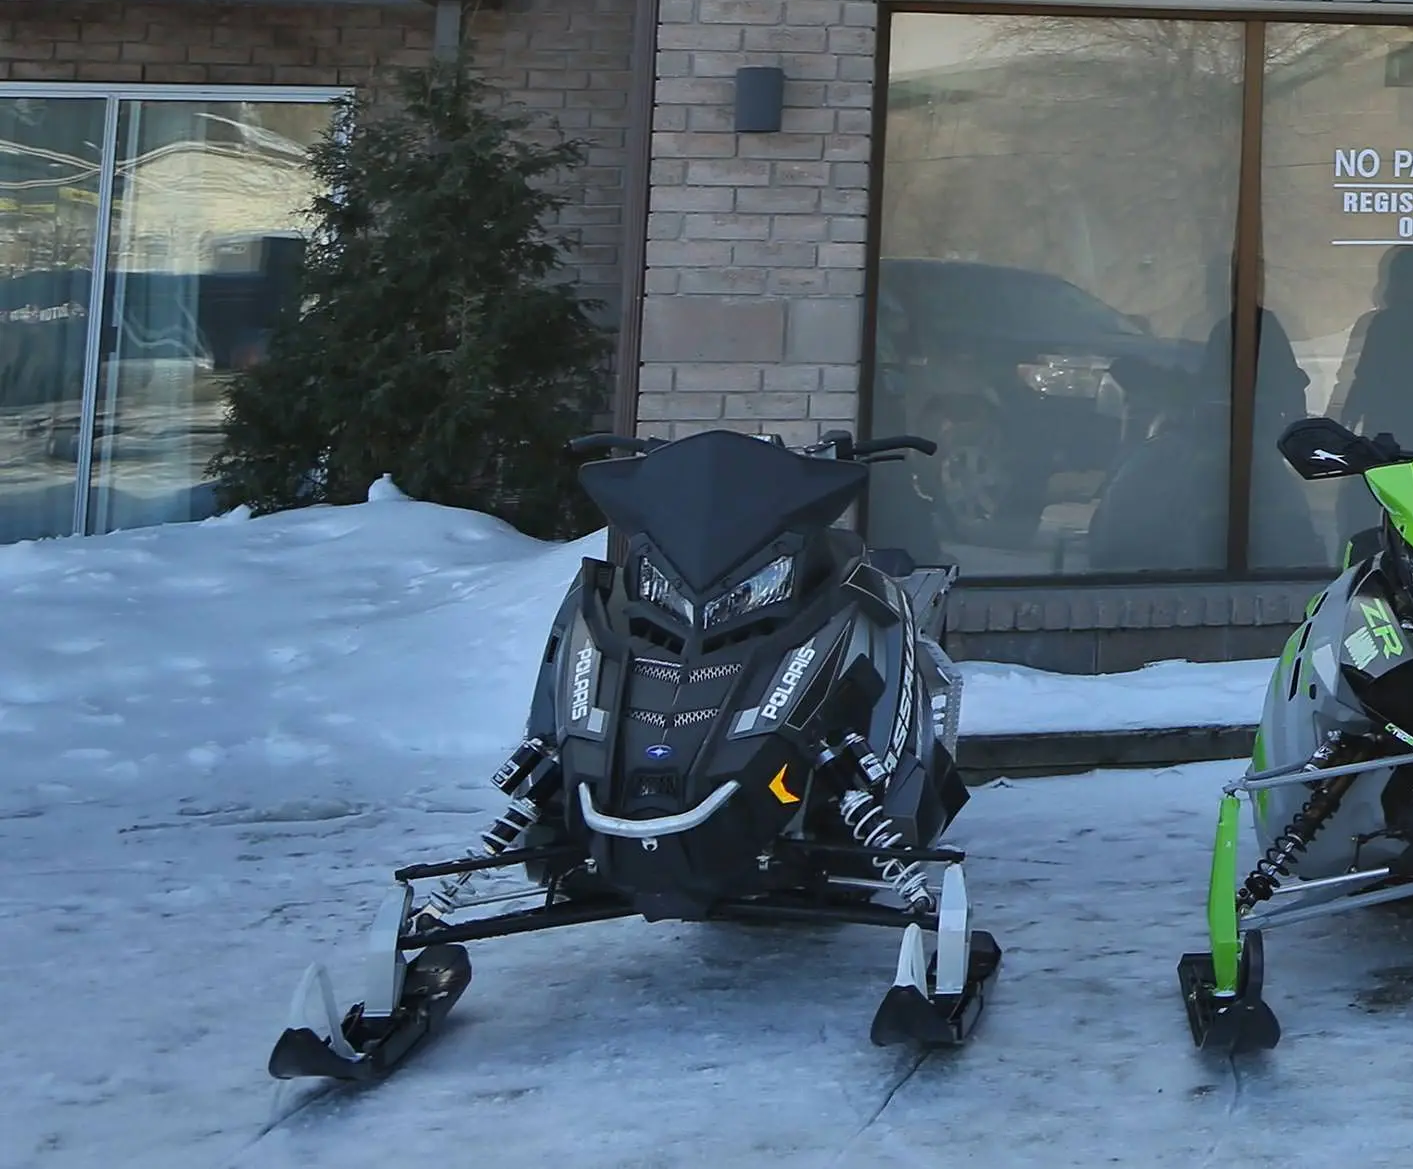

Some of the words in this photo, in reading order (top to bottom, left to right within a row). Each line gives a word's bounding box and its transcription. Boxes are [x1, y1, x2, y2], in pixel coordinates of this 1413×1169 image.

[1334, 149, 1381, 178] NO
[1360, 598, 1403, 660] ZR
[572, 648, 592, 720] POLARIS
[761, 646, 815, 720] POLARIS
